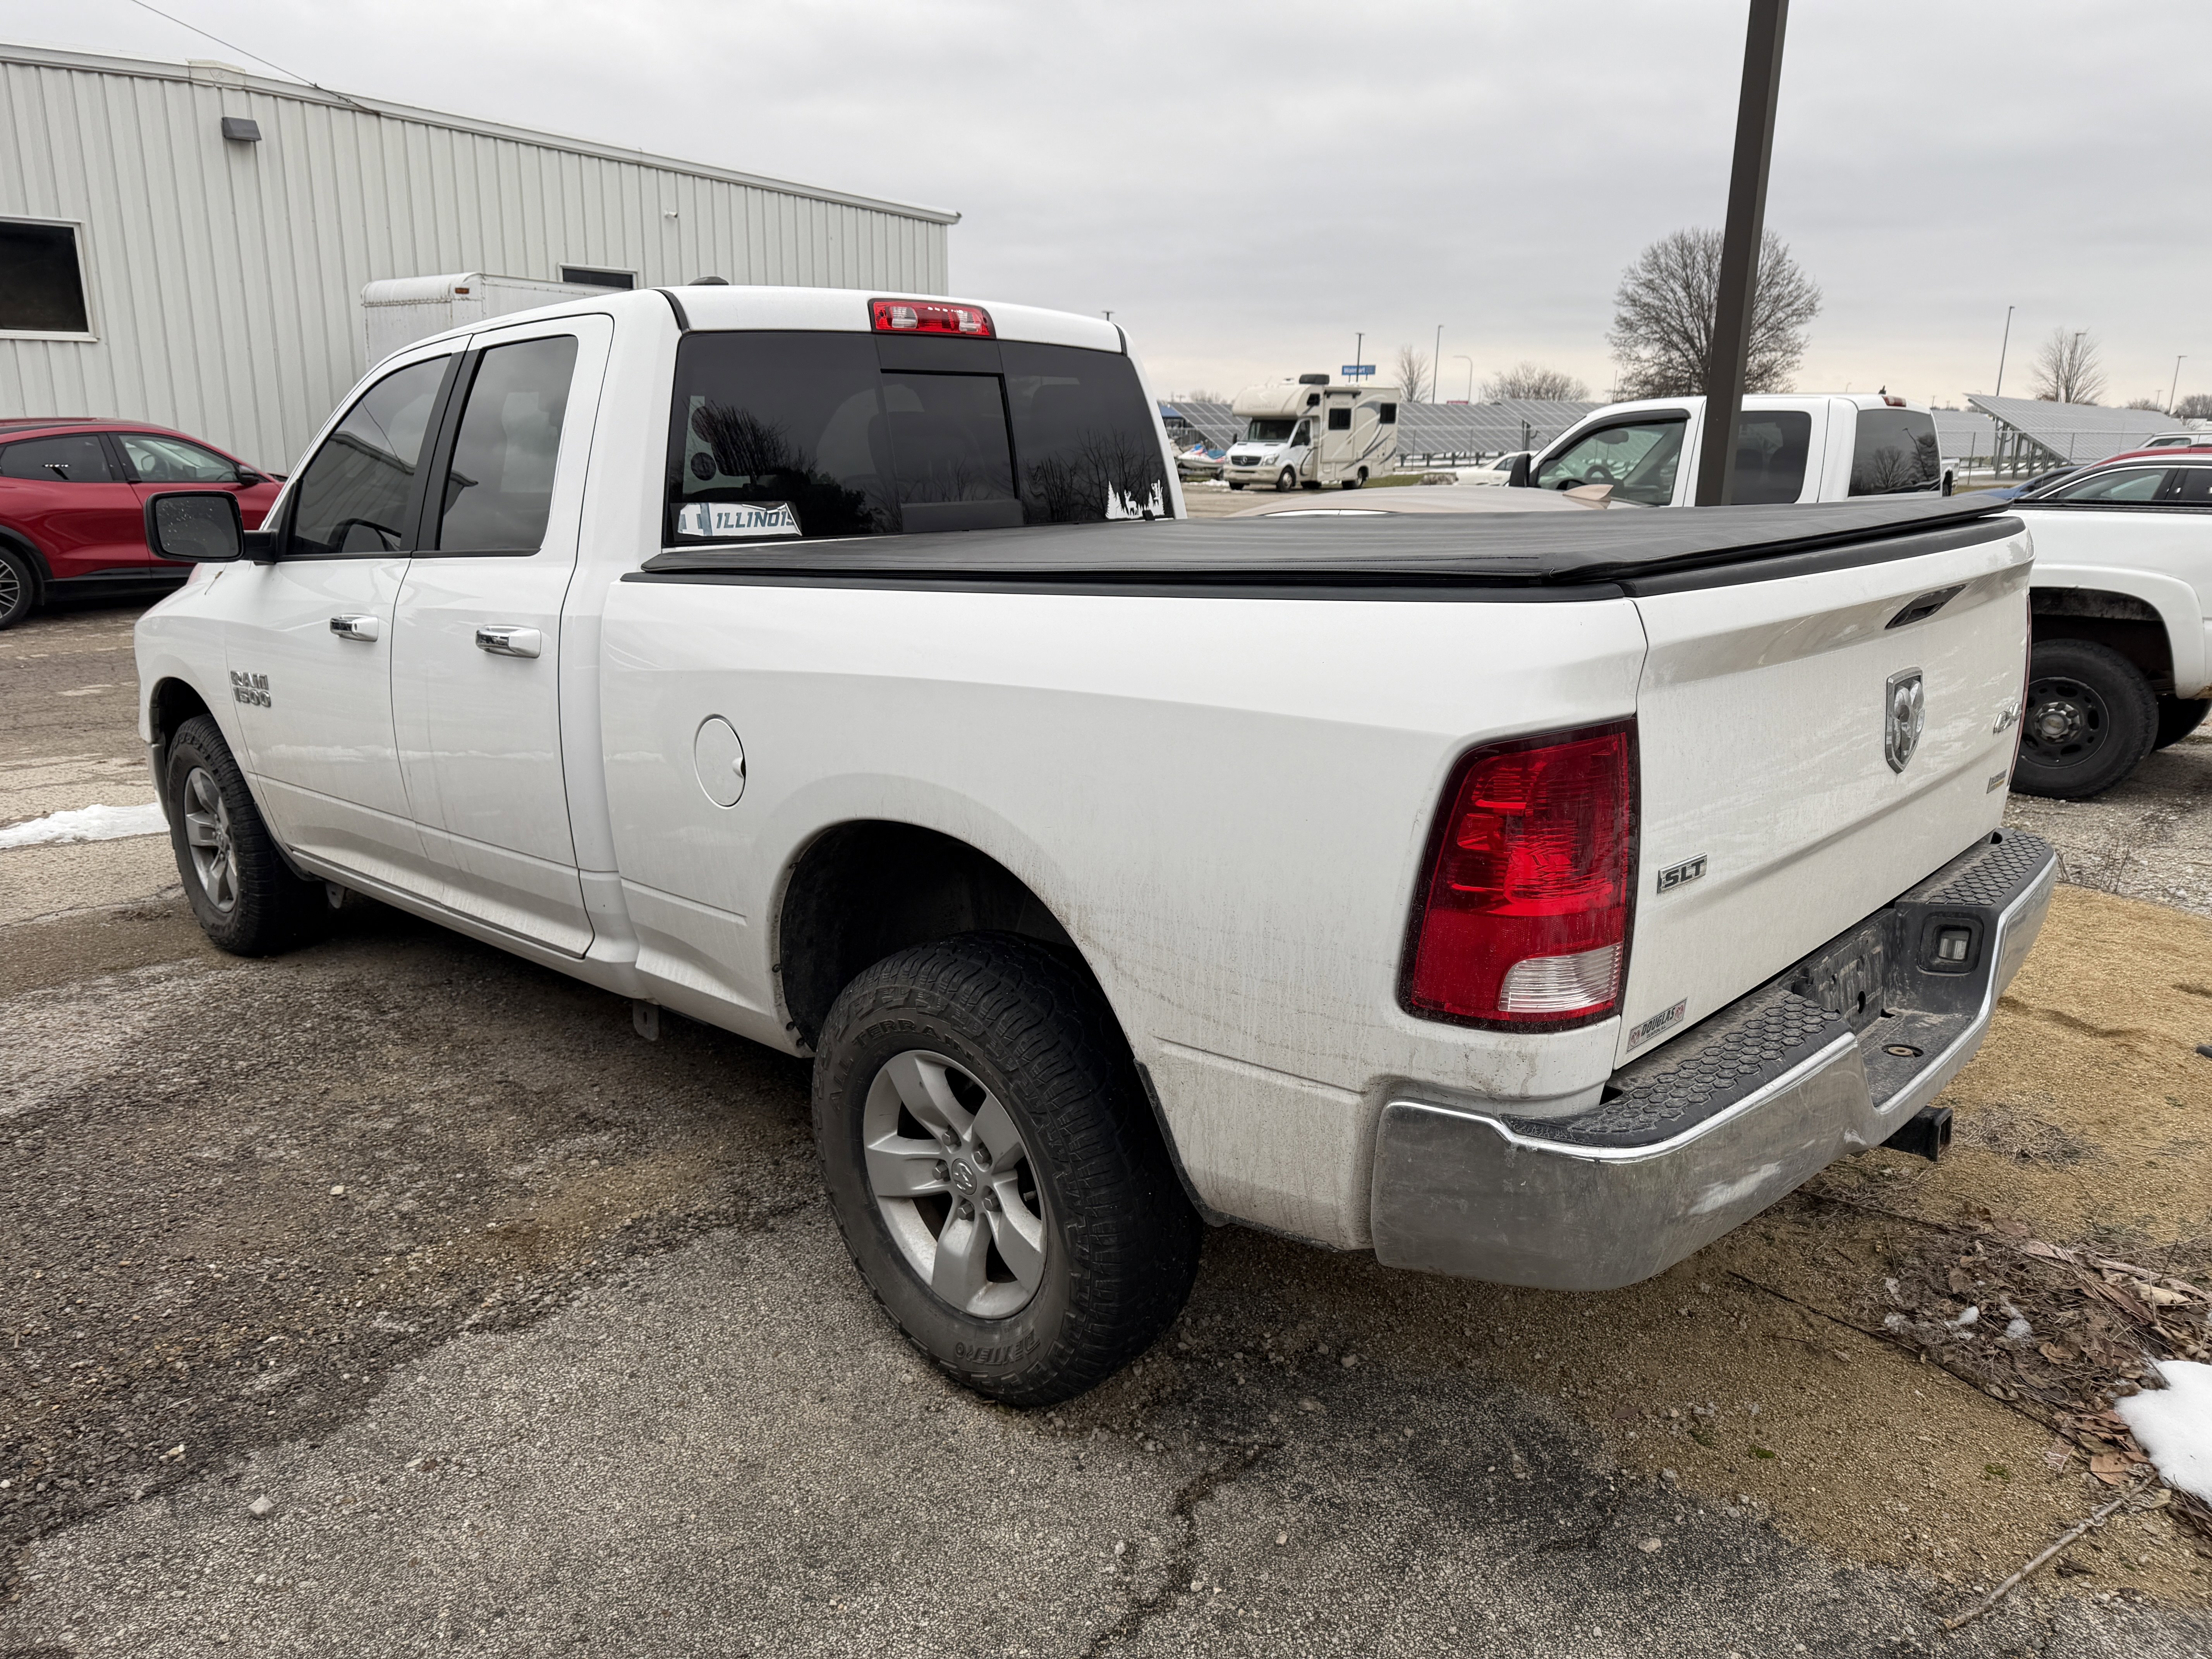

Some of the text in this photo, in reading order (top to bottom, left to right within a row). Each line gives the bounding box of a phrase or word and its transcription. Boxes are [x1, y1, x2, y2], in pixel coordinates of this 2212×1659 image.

[230, 670, 269, 690] RAM
[233, 687, 271, 708] 1500
[1665, 859, 1704, 888] SLT
[1641, 1006, 1676, 1037] DOUGLAS
[852, 1018, 974, 1062] TERRAIN
